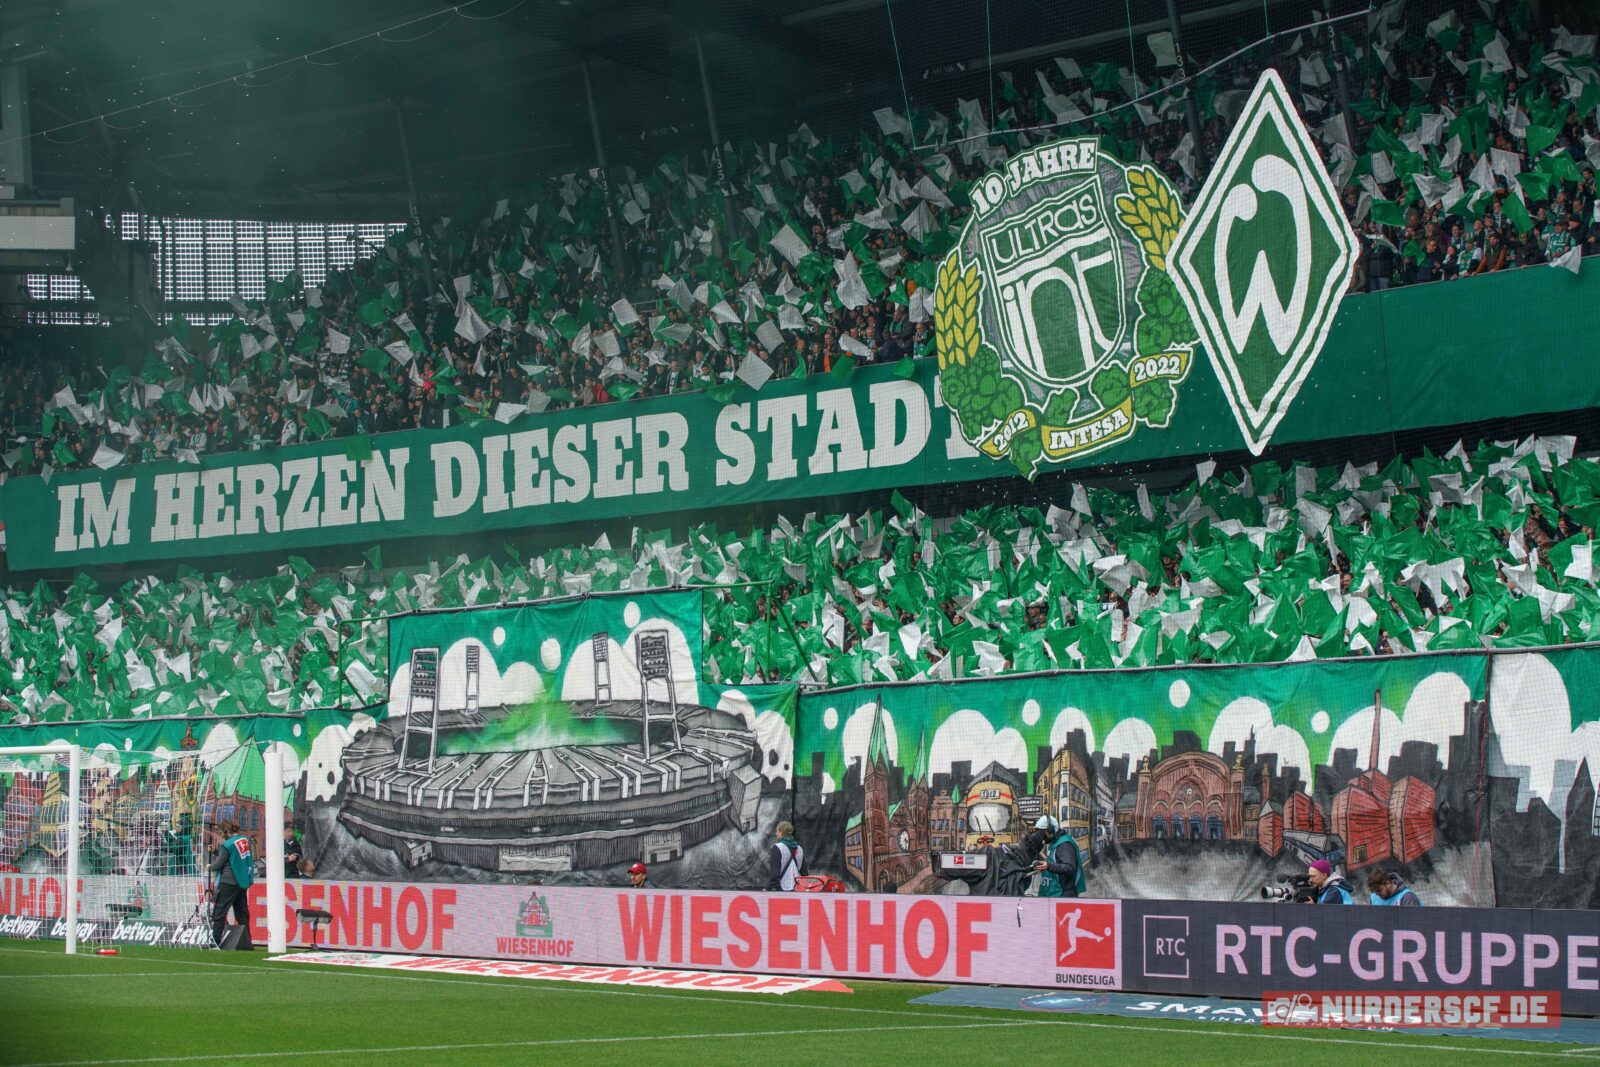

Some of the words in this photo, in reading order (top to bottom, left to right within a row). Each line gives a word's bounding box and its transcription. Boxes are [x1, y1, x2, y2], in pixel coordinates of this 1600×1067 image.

[971, 178, 1004, 214] 10
[1009, 142, 1096, 187] JAHRE
[1132, 355, 1182, 383] 2022
[992, 411, 1030, 452] 2012
[1049, 409, 1131, 451] INTESA
[55, 478, 136, 552] IM
[150, 447, 410, 545] HERZEN
[430, 411, 690, 518] DIESER
[112, 920, 166, 946] betway
[496, 937, 575, 957] WIESENHOF
[616, 893, 993, 978] WIESENHOF
[1155, 937, 1186, 956] RTC
[388, 957, 812, 991] WIESENHOF
[1215, 923, 1600, 990] RTC-GRUPPE
[1055, 973, 1116, 986] BUNDESLIGA
